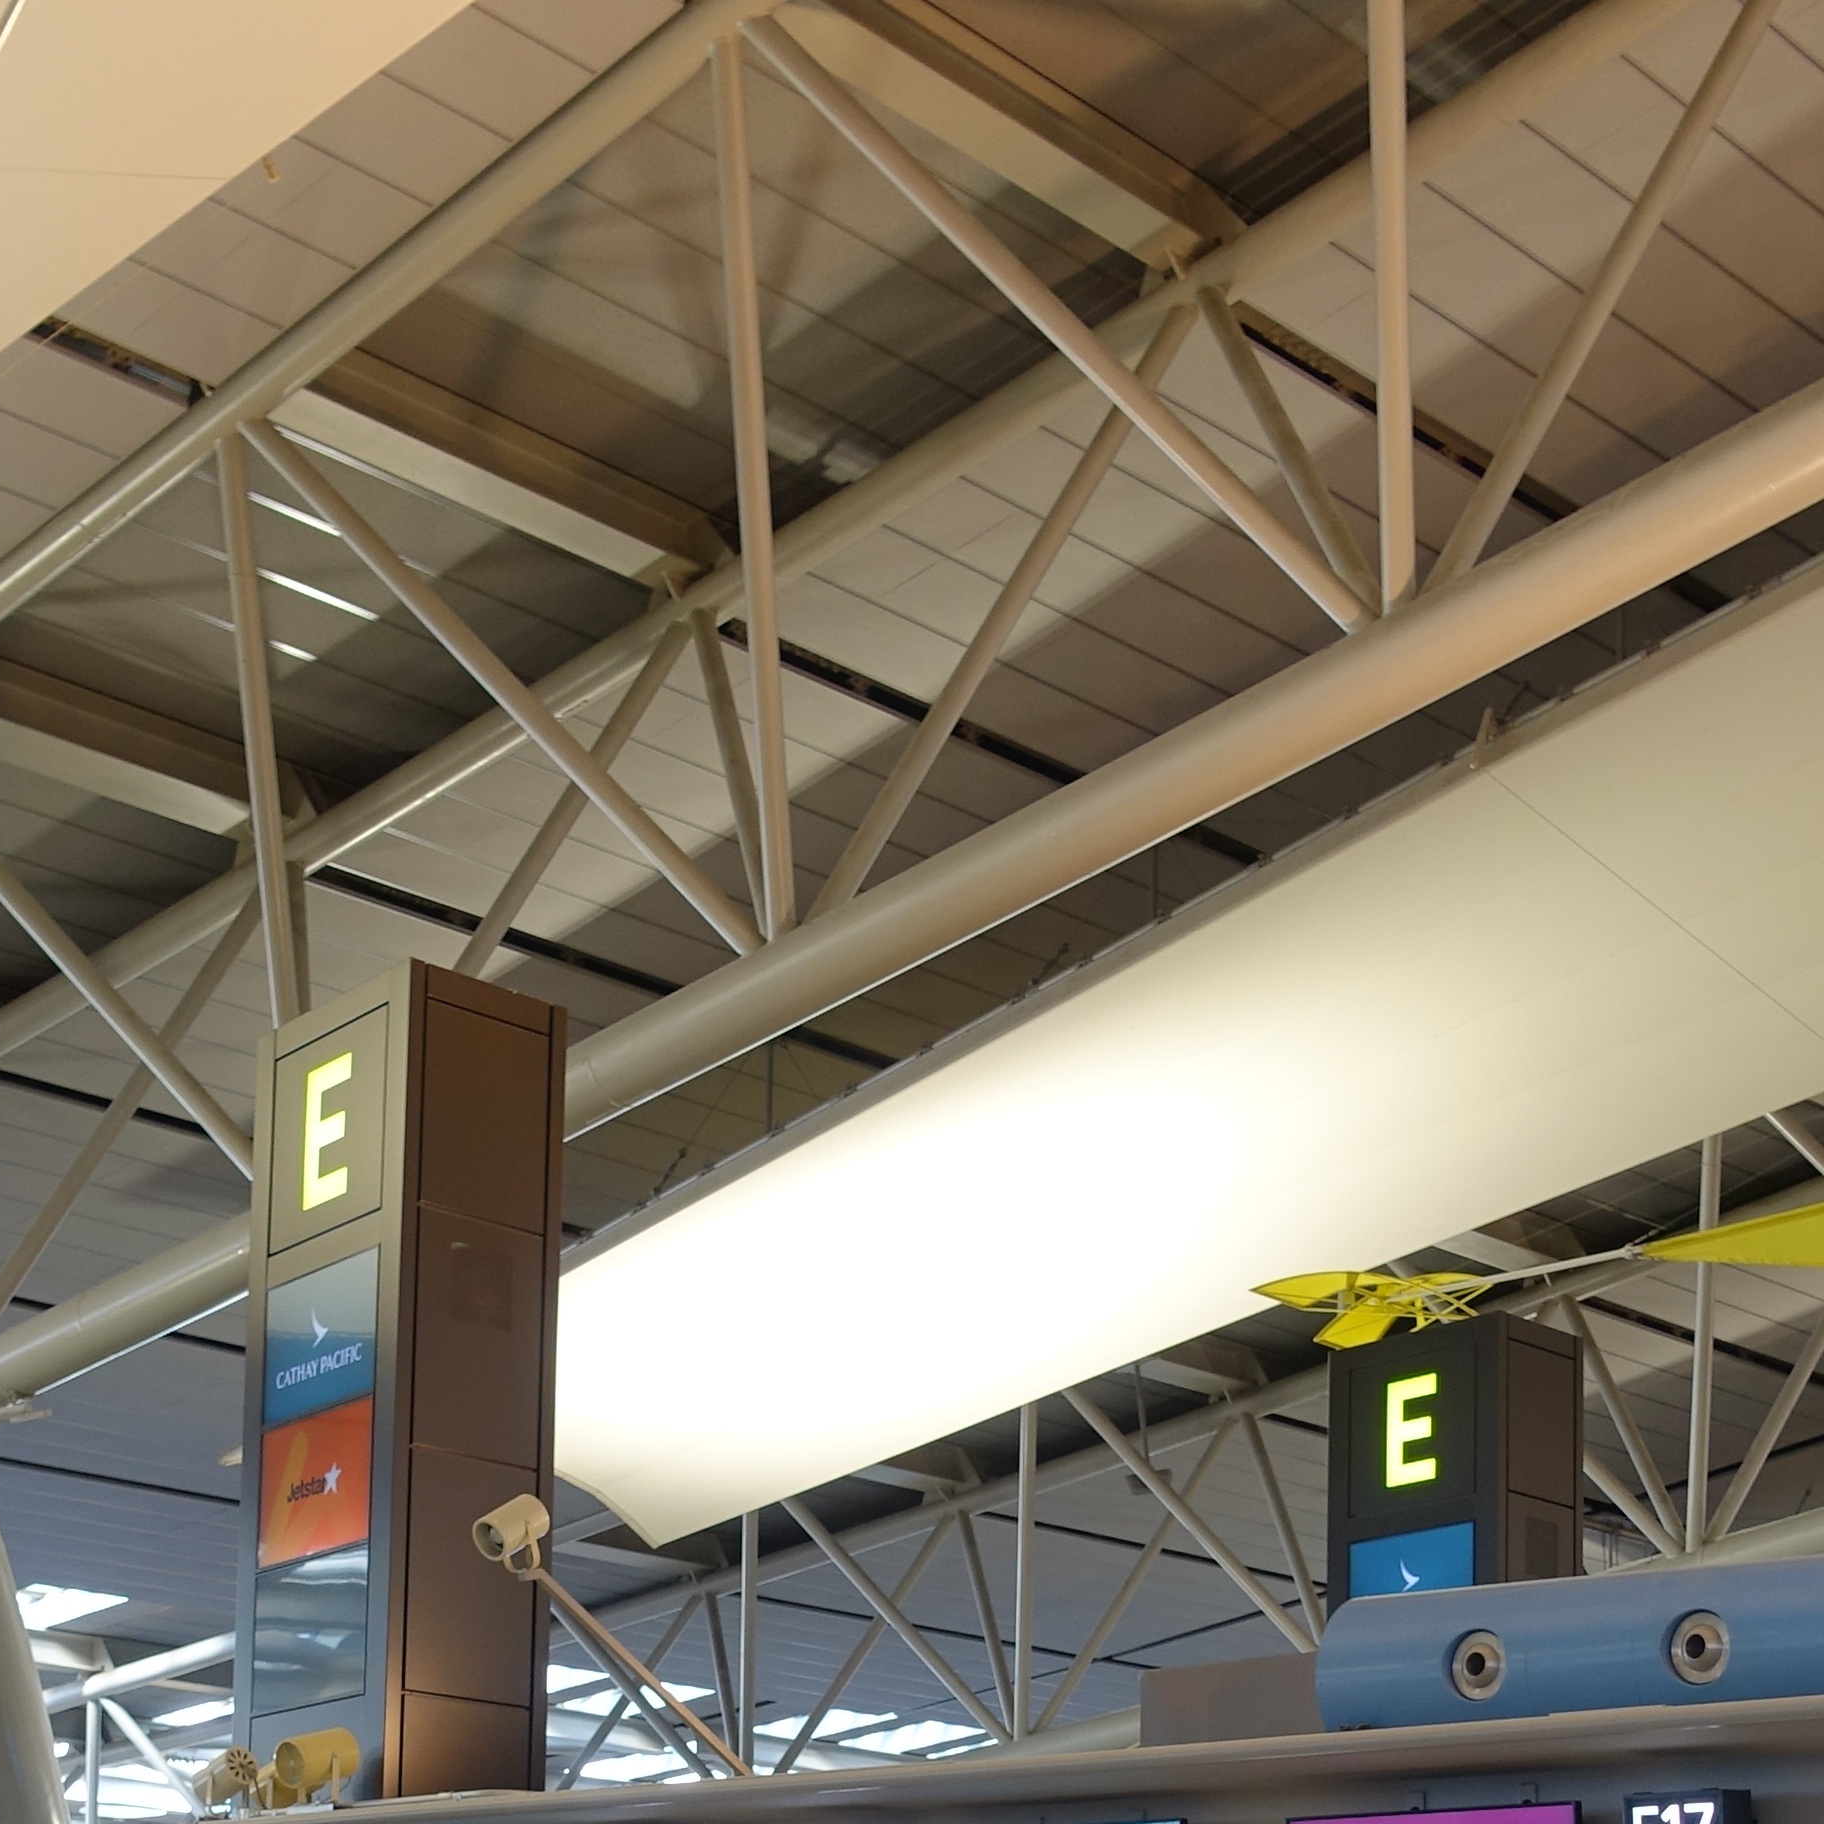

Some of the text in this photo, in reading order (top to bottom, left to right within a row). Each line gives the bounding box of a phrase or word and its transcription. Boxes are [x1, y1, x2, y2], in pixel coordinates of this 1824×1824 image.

[301, 1051, 354, 1212] E
[276, 1342, 363, 1390] CATHAY PACIFIC
[1385, 1372, 1438, 1490] E
[287, 1476, 327, 1503] Jetstar
